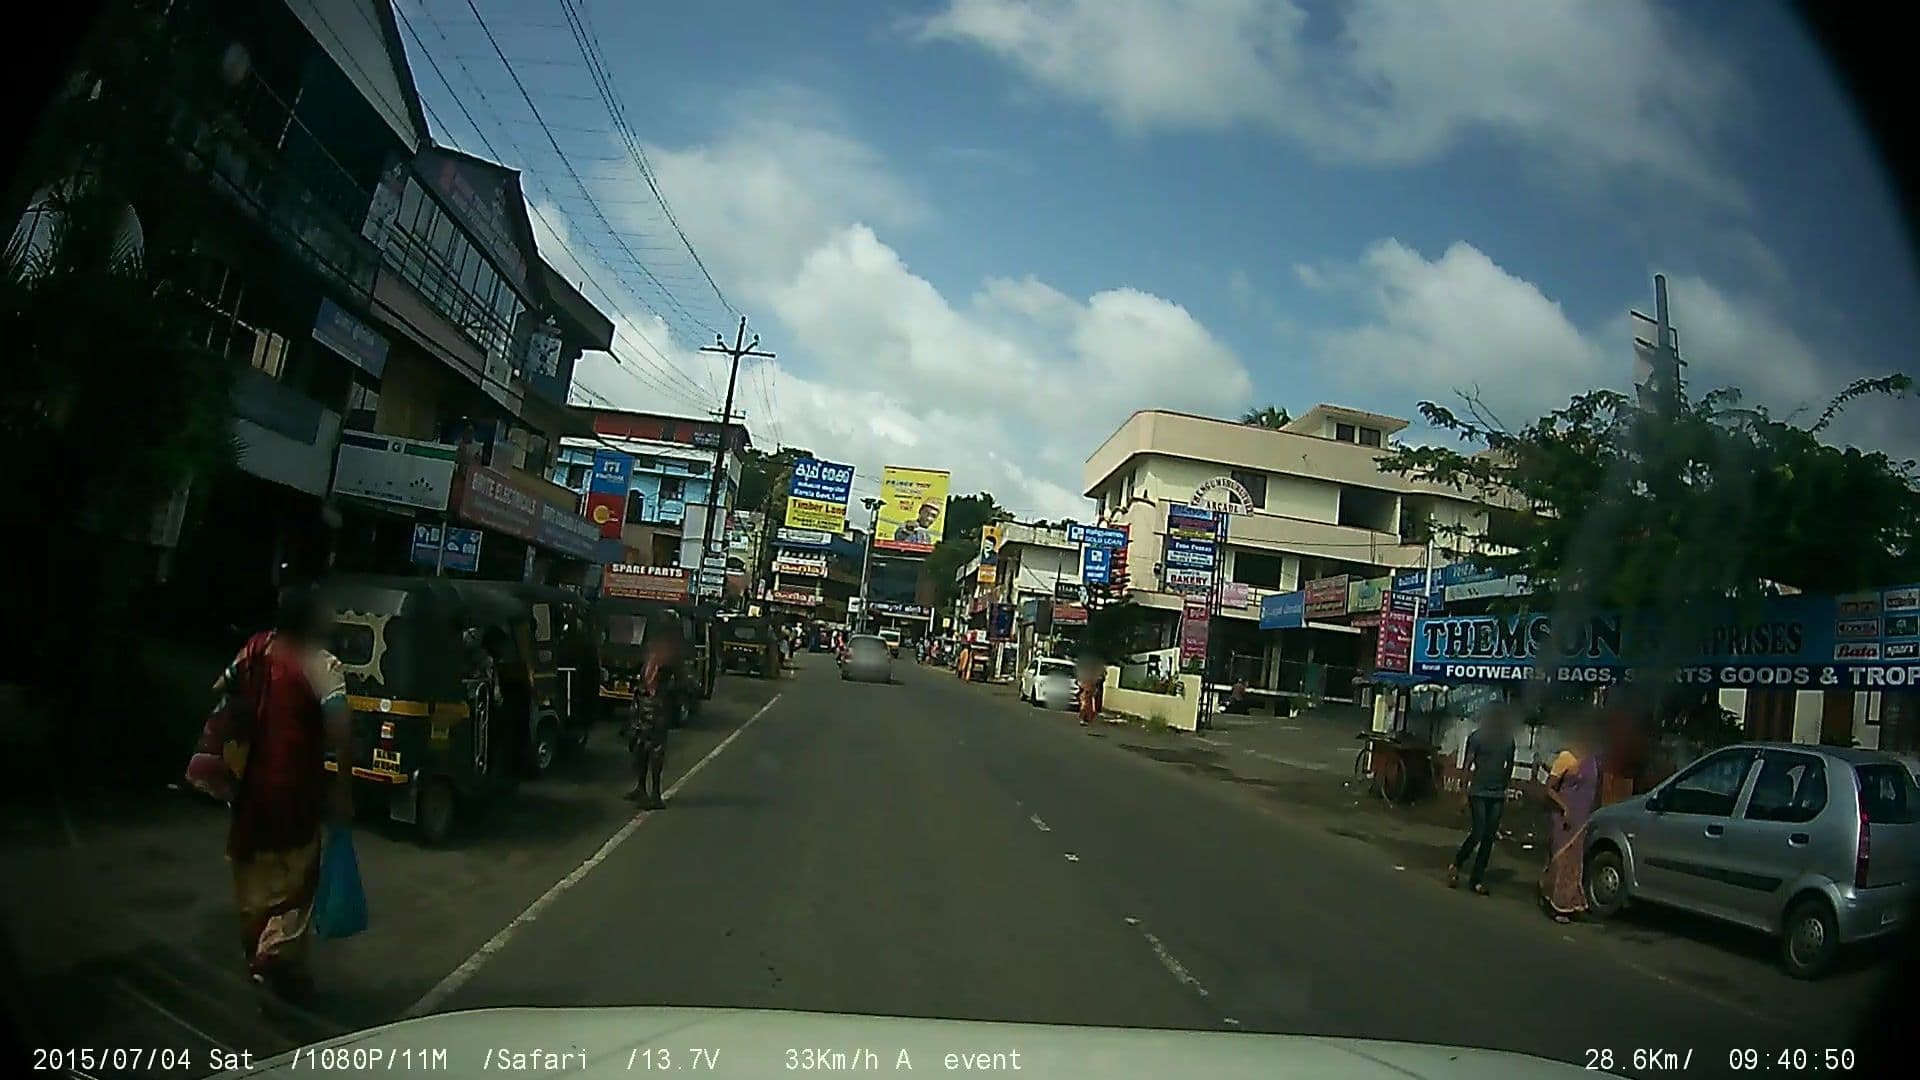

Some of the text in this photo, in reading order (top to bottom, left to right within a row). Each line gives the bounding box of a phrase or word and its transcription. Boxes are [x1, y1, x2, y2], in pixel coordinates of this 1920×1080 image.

[792, 499, 823, 512] Timber
[1206, 501, 1238, 514] ARCADE
[1104, 538, 1123, 547] LOAN
[612, 564, 683, 578] SPARE PARTS
[1171, 575, 1208, 585] BAKERY
[1837, 643, 1877, 658] Bata
[1557, 667, 1617, 684] BAGS,
[1719, 666, 1810, 685] GOODS
[1819, 667, 1839, 685] &
